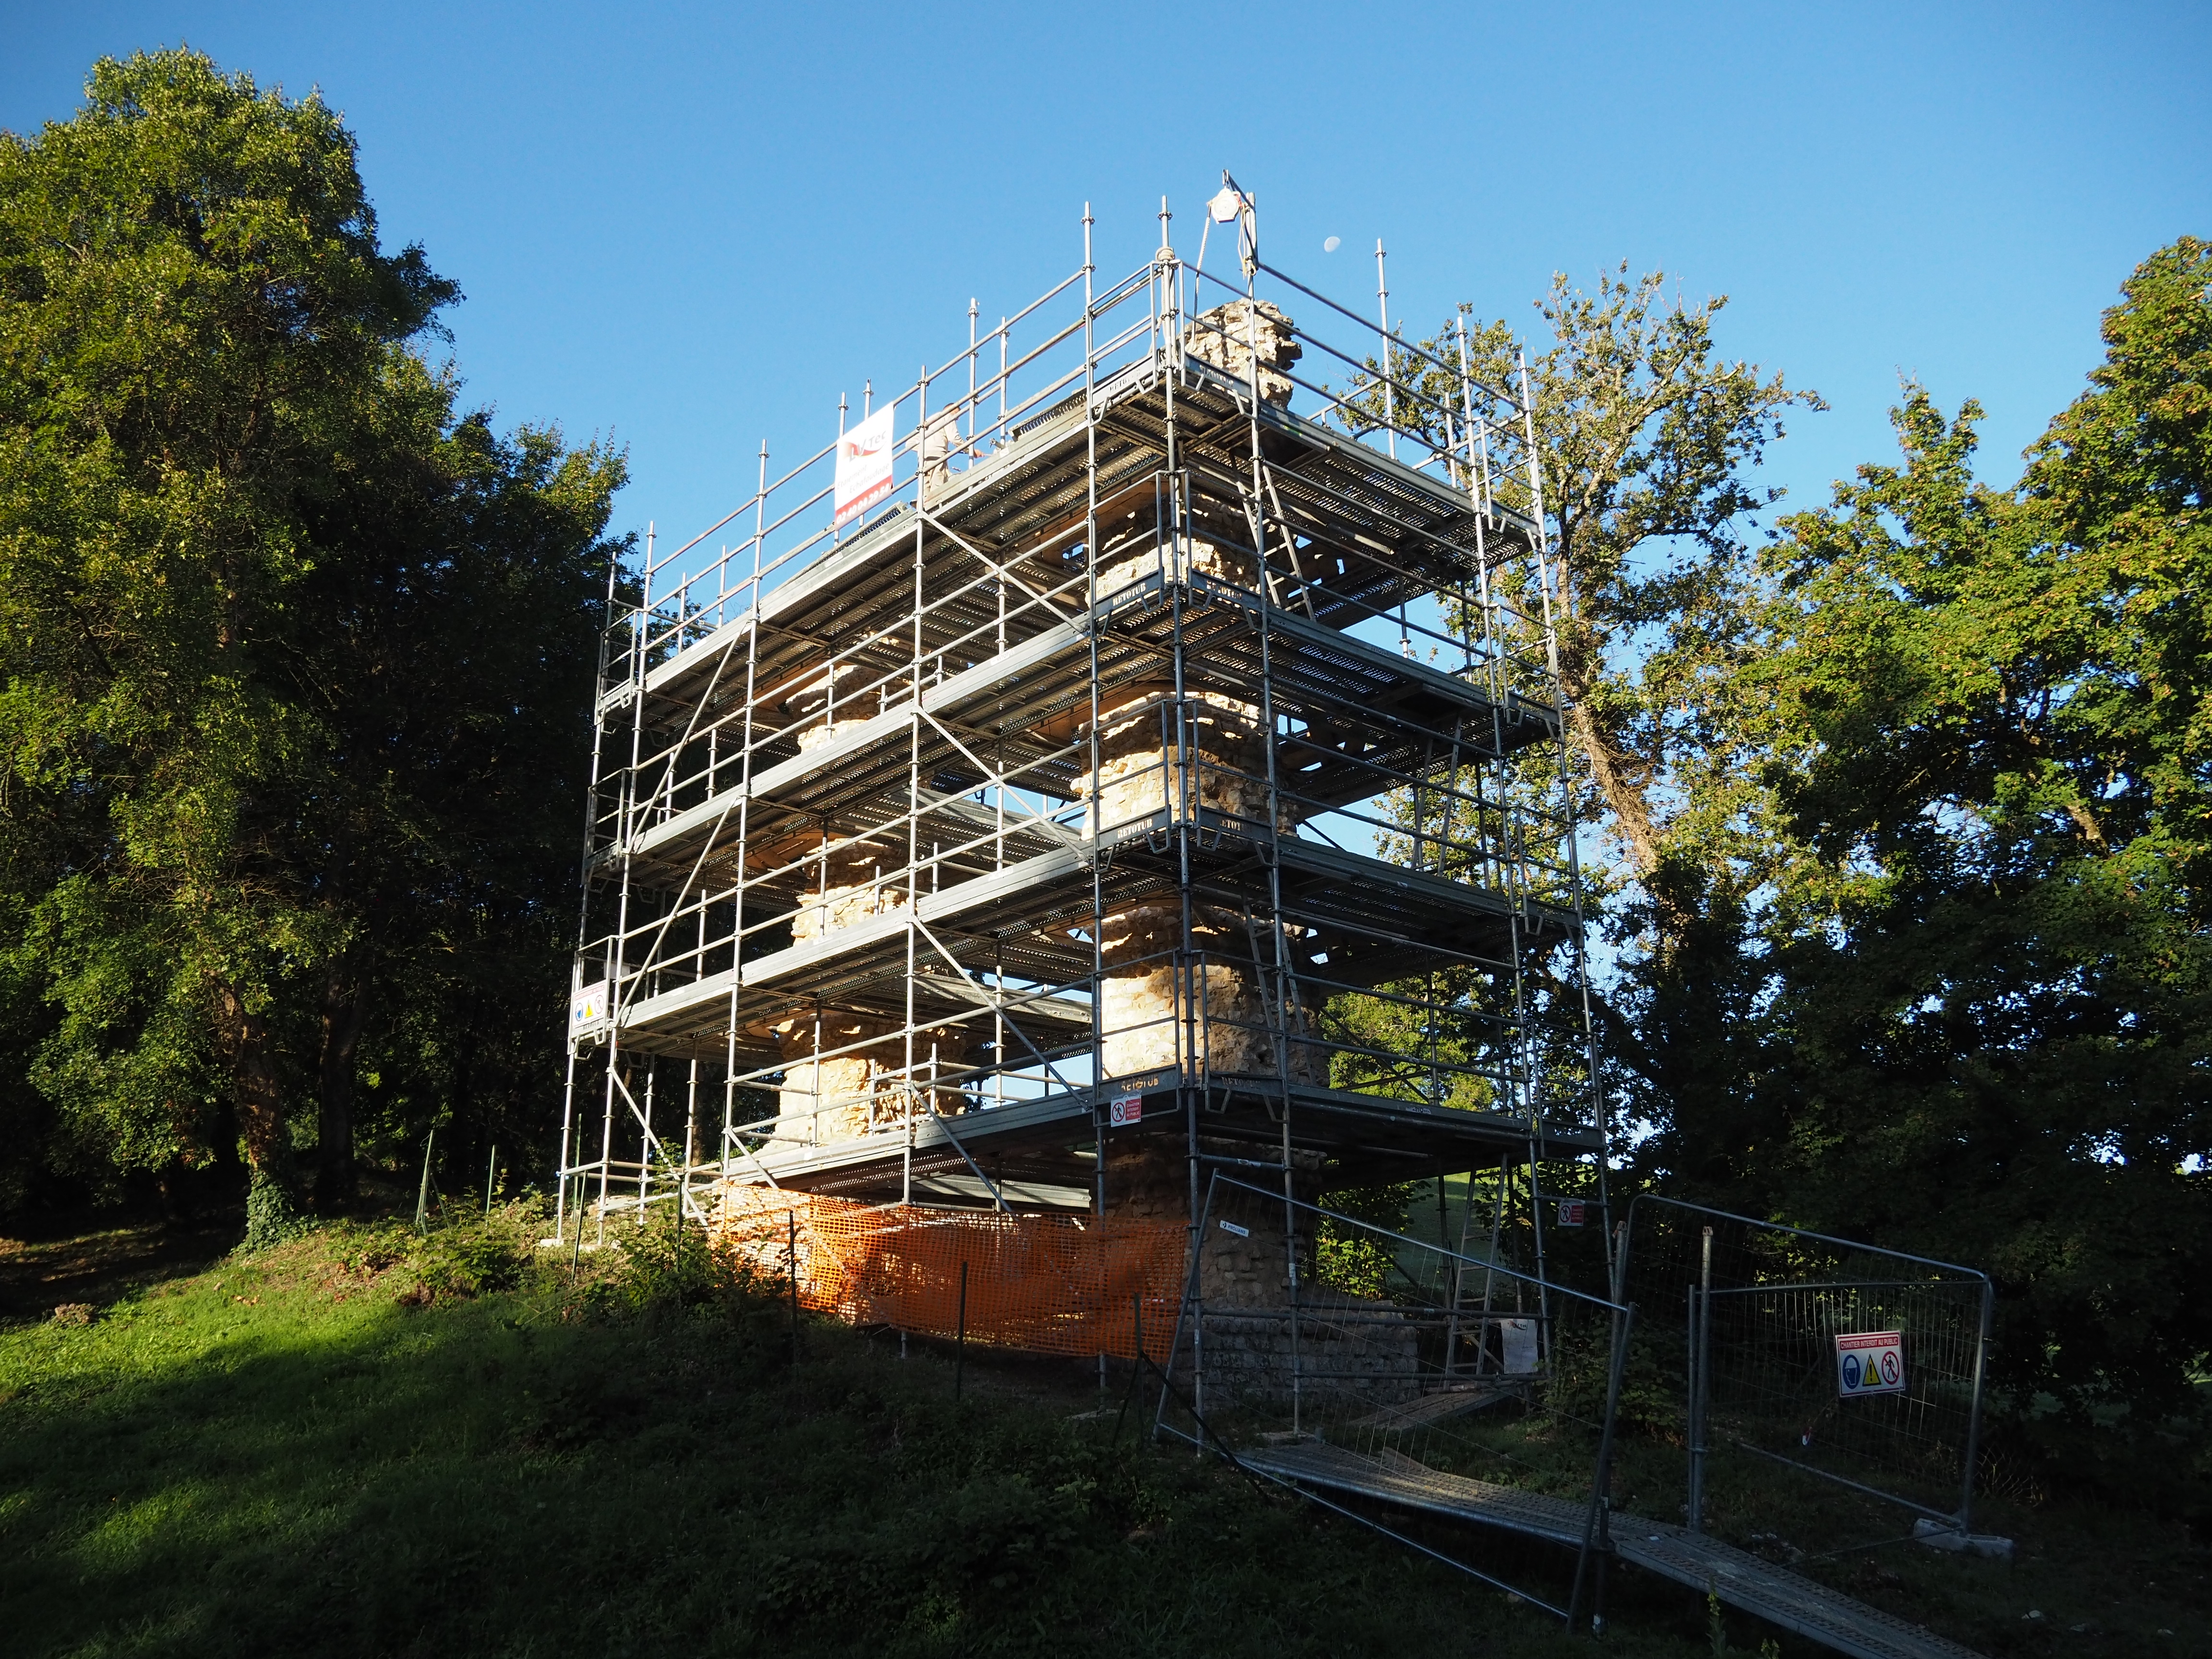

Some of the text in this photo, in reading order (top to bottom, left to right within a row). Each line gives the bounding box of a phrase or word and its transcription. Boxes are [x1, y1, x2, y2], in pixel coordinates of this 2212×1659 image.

[836, 483, 890, 524] 02 40 04 29 54
[1113, 582, 1146, 606] RETOTUB
[1117, 818, 1153, 839] RETOTUB
[1228, 1225, 1246, 1234] PROLIANS
[1840, 1340, 1861, 1349] CHANTIER
[1860, 1339, 1877, 1347] INTERDIT
